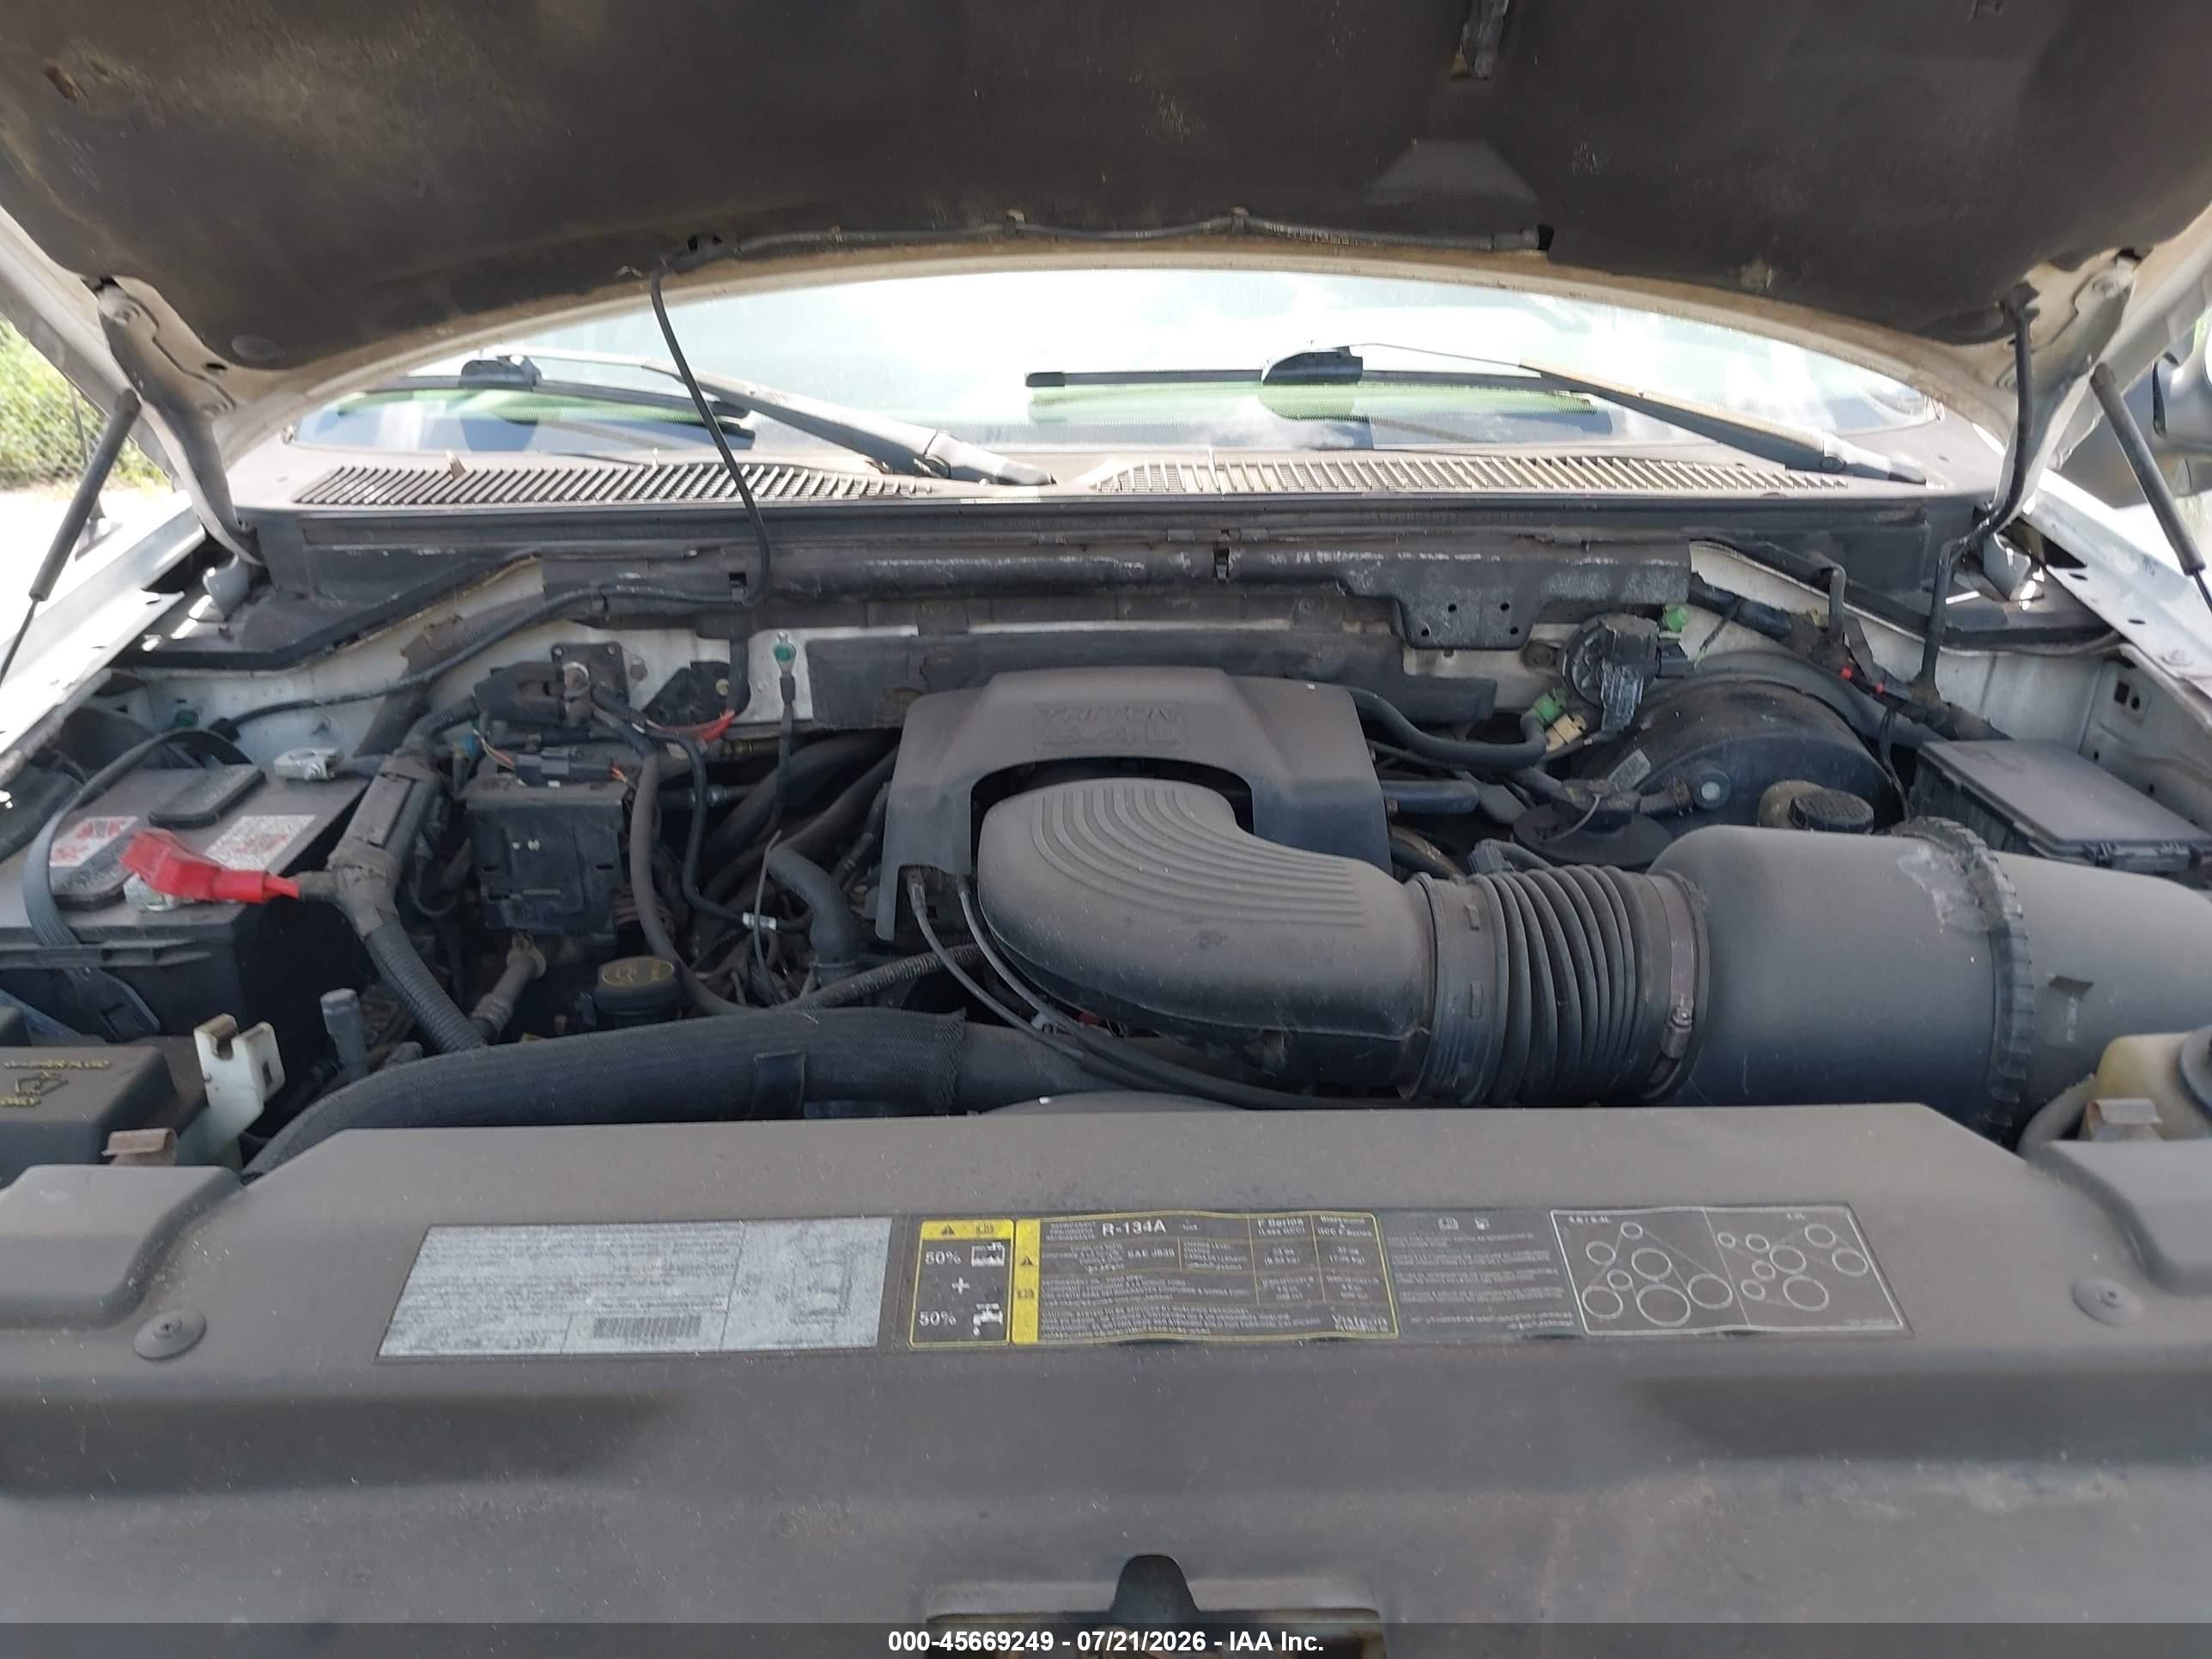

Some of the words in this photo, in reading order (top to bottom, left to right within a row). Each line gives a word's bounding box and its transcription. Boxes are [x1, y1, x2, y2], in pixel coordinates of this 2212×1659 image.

[1102, 1218, 1167, 1237] R-134A
[925, 1250, 962, 1266] 50%
[919, 1310, 957, 1327] 50%
